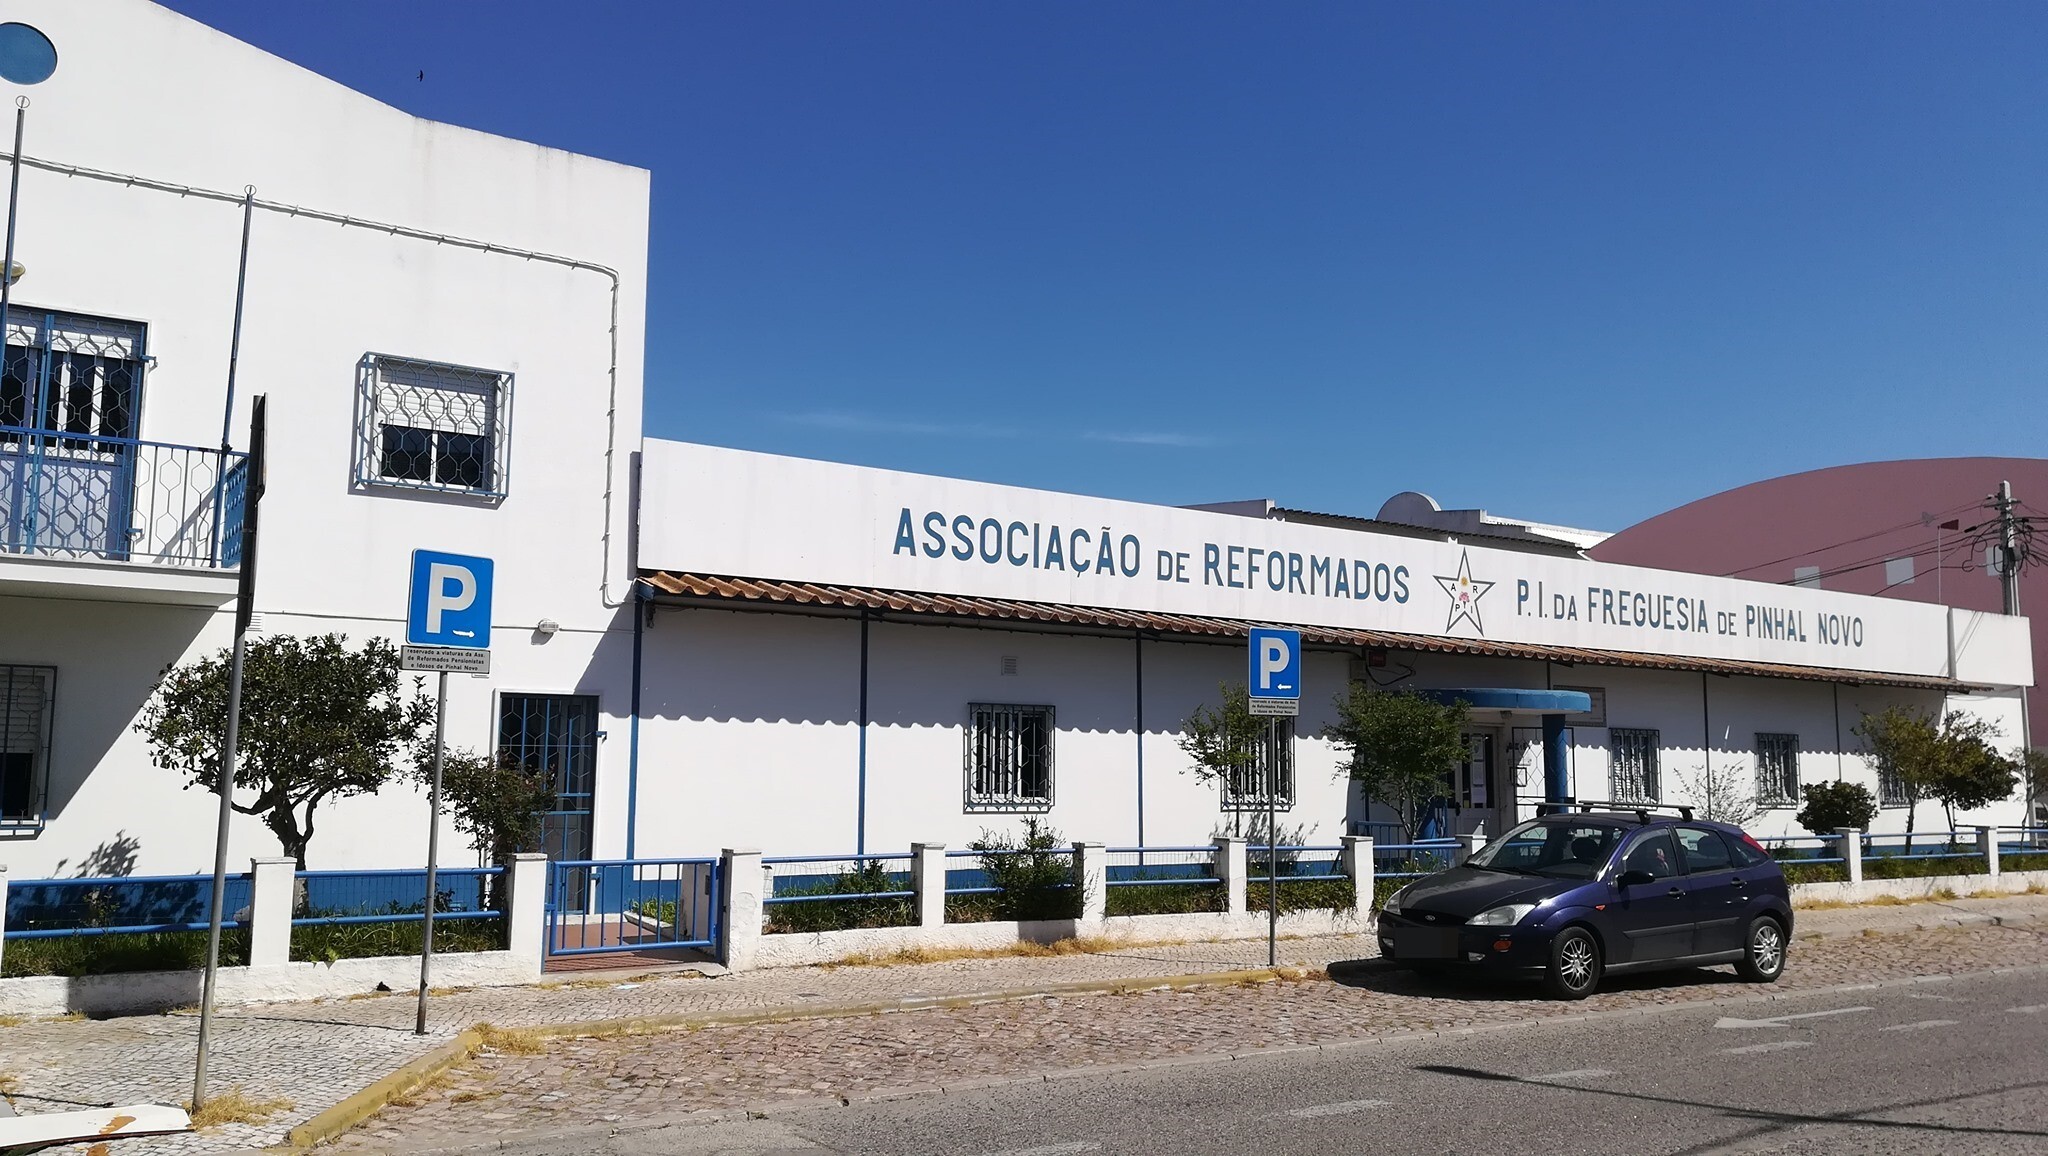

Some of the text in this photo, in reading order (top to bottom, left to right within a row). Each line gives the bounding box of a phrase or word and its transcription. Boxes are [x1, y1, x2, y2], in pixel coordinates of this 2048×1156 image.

[893, 507, 1410, 605] ASSOCIAÇÃO DE REFORMADOS
[426, 562, 477, 634] P
[1450, 583, 1479, 594] A R
[1455, 603, 1461, 612] P
[1588, 586, 1709, 634] FREGUESIA
[1717, 611, 1738, 636] DE
[1745, 604, 1807, 643] PINHAL
[1818, 612, 1863, 648] NOVO
[416, 655, 449, 663] Reformados
[451, 657, 485, 665] Pensionistas
[1260, 636, 1290, 689] P
